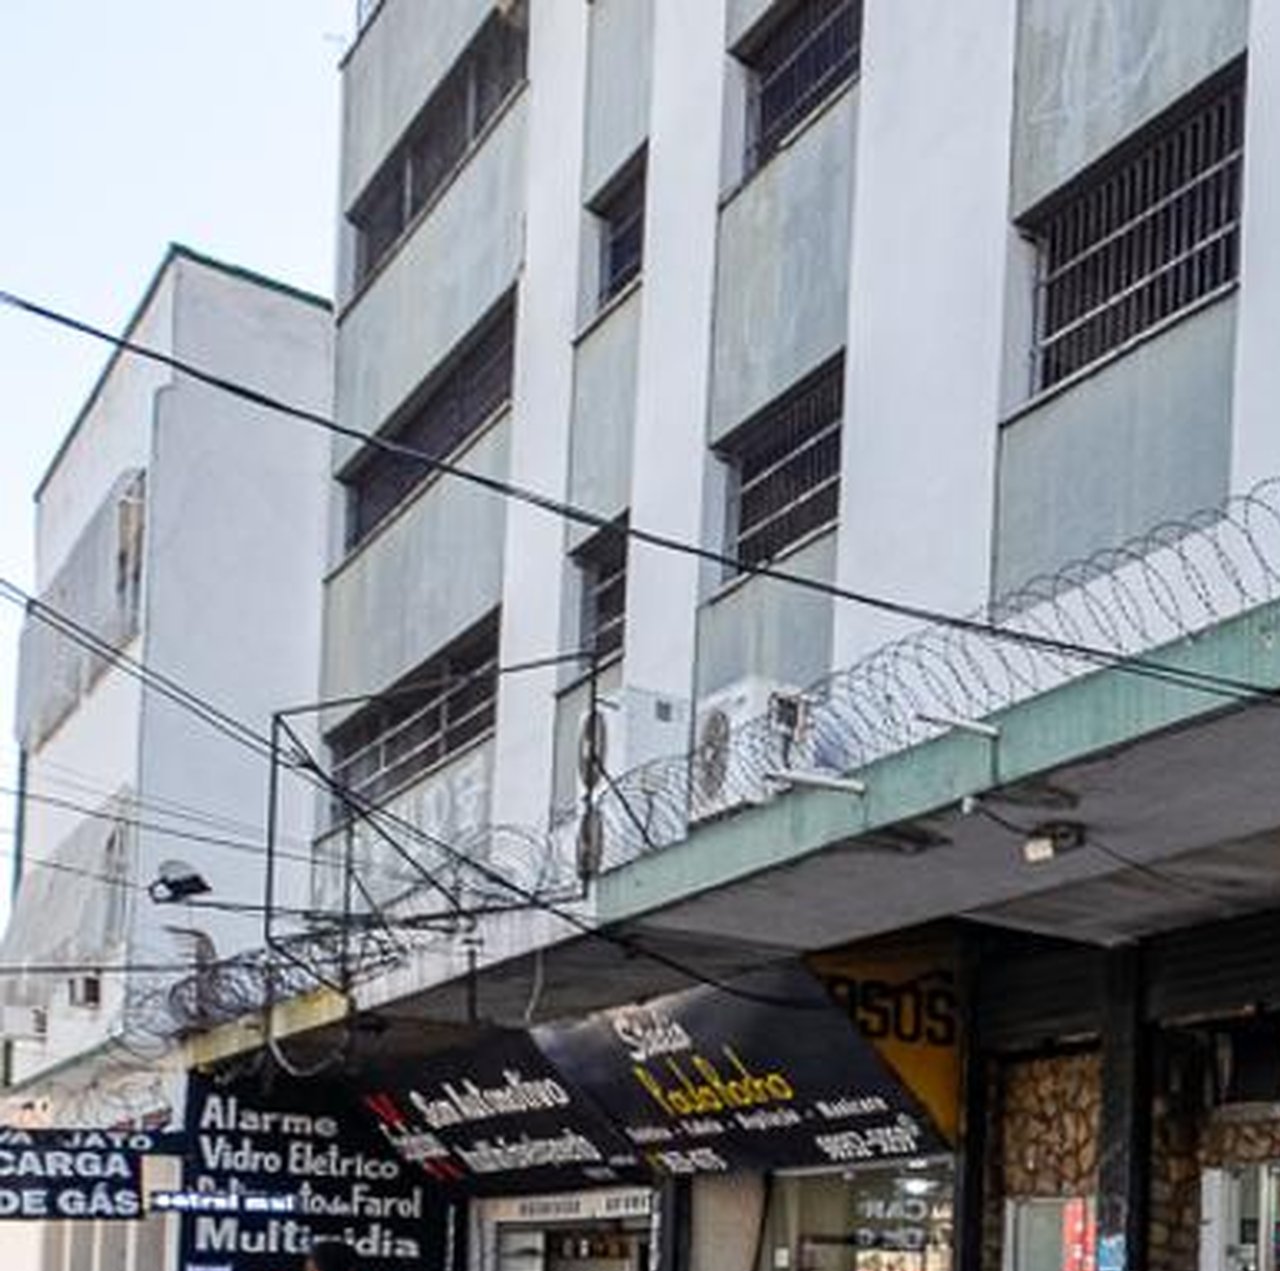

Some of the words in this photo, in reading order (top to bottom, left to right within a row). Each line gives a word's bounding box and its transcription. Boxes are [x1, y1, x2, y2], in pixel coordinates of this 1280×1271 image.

[201, 1094, 338, 1137] Alarme
[200, 1134, 282, 1173] Vidro
[57, 1181, 140, 1216] GÁS
[351, 1183, 422, 1219] Farol
